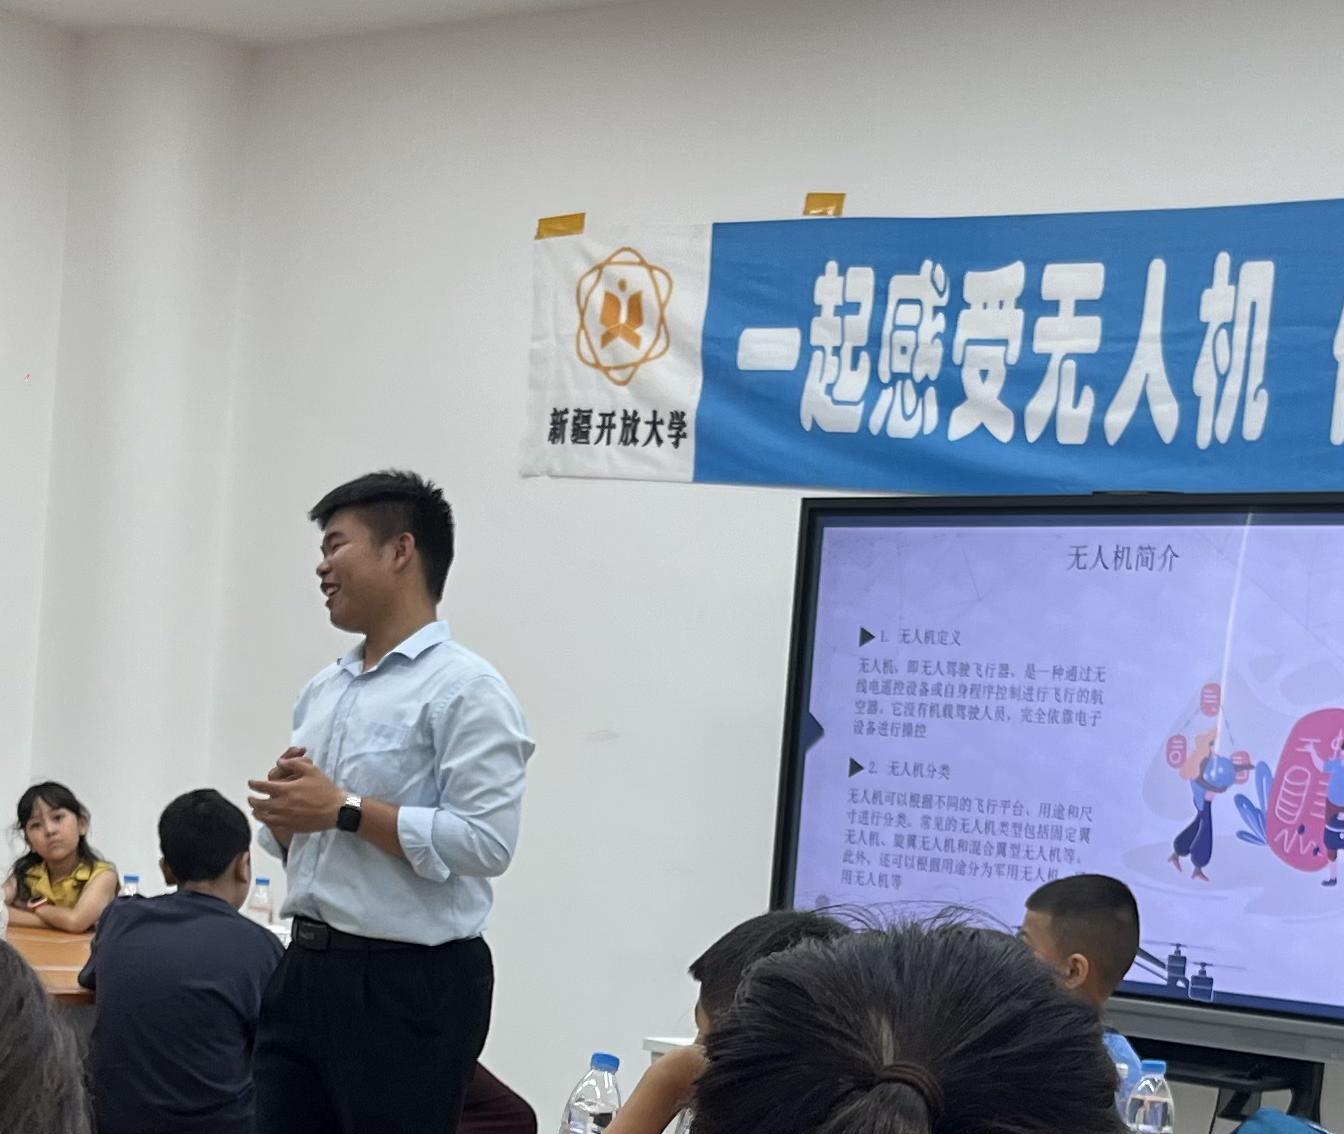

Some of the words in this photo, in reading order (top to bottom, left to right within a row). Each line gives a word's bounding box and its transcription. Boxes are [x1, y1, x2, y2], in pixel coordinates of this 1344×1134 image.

[736, 249, 1275, 449] 一起感受无人机
[547, 408, 688, 449] 新疆开放大学
[1067, 544, 1180, 572] 无人机简介
[898, 629, 961, 646] 无人机定义
[853, 719, 927, 738] 设备进行操控
[887, 761, 951, 780] 无人机分类
[840, 869, 902, 889] 用无人机等
